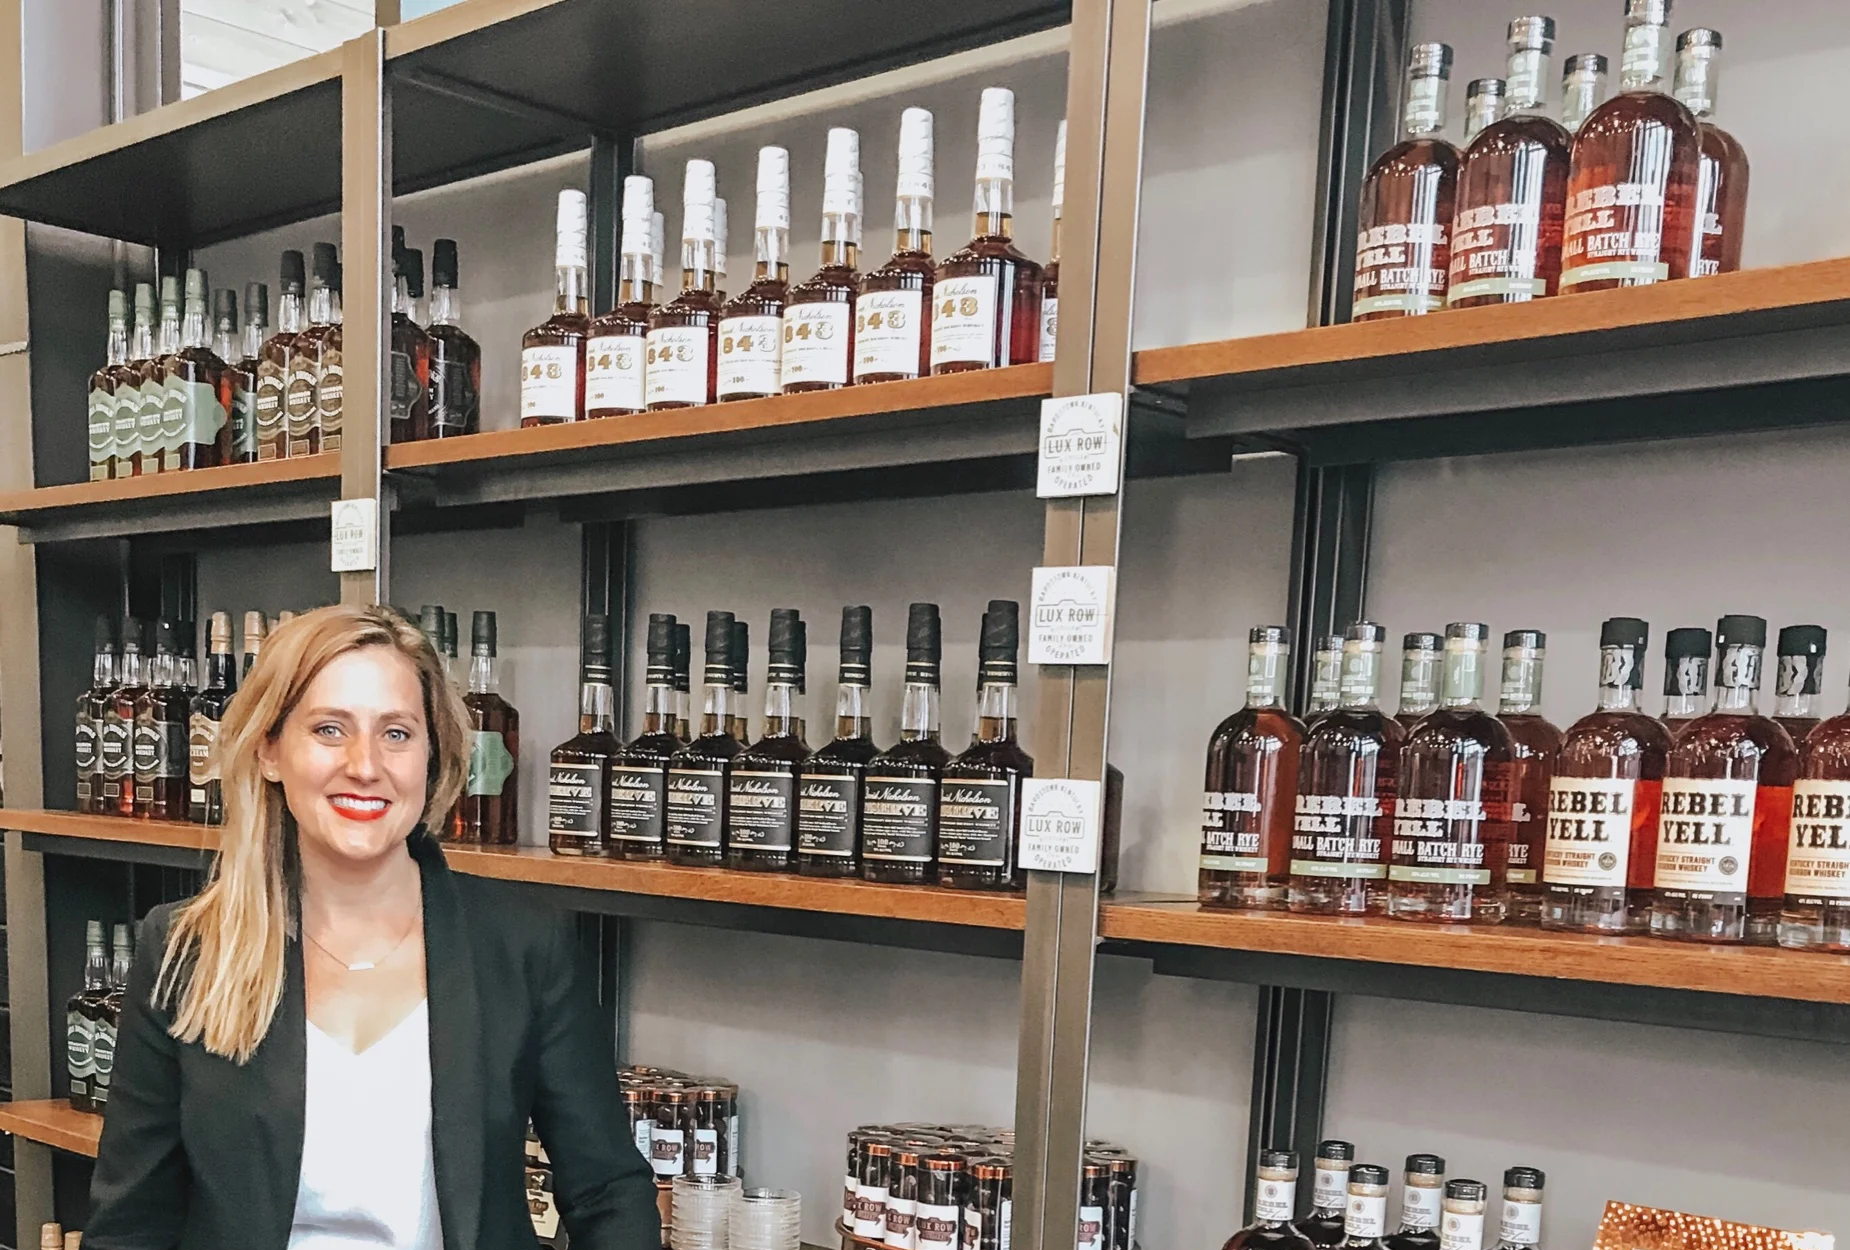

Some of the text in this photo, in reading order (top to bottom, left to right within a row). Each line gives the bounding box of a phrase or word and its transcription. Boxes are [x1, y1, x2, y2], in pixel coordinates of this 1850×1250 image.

[1587, 232, 1630, 251] BATCH
[1469, 250, 1508, 267] BATCH
[1380, 268, 1420, 284] BATCH
[1048, 436, 1102, 454] LUX ROW
[1047, 462, 1101, 474] FAMILY OWNED
[1054, 474, 1093, 489] OPERATED
[1039, 608, 1095, 622] LUX ROW
[1039, 633, 1093, 643] FAMILY OWNED
[1045, 645, 1085, 659] OPERATED
[878, 786, 921, 801] Nicholson
[950, 788, 992, 804] Nicholson
[1549, 790, 1628, 816] REBEL
[1662, 791, 1750, 818] REBEL
[1029, 819, 1081, 834] LUX ROW
[1549, 818, 1609, 842] YELL
[1663, 820, 1731, 846] YELL
[1237, 832, 1260, 847] RYE
[1796, 824, 1850, 849] YEL
[1028, 843, 1079, 854] FAMILY OWNED
[1316, 836, 1381, 853] BATCH RYE
[1417, 841, 1485, 858] BATCH RYE
[1034, 854, 1072, 869] OPERATED
[1678, 864, 1708, 872] WHISKEY
[1681, 856, 1715, 865] STRAIGHT
[1813, 869, 1846, 878] WHISKEY
